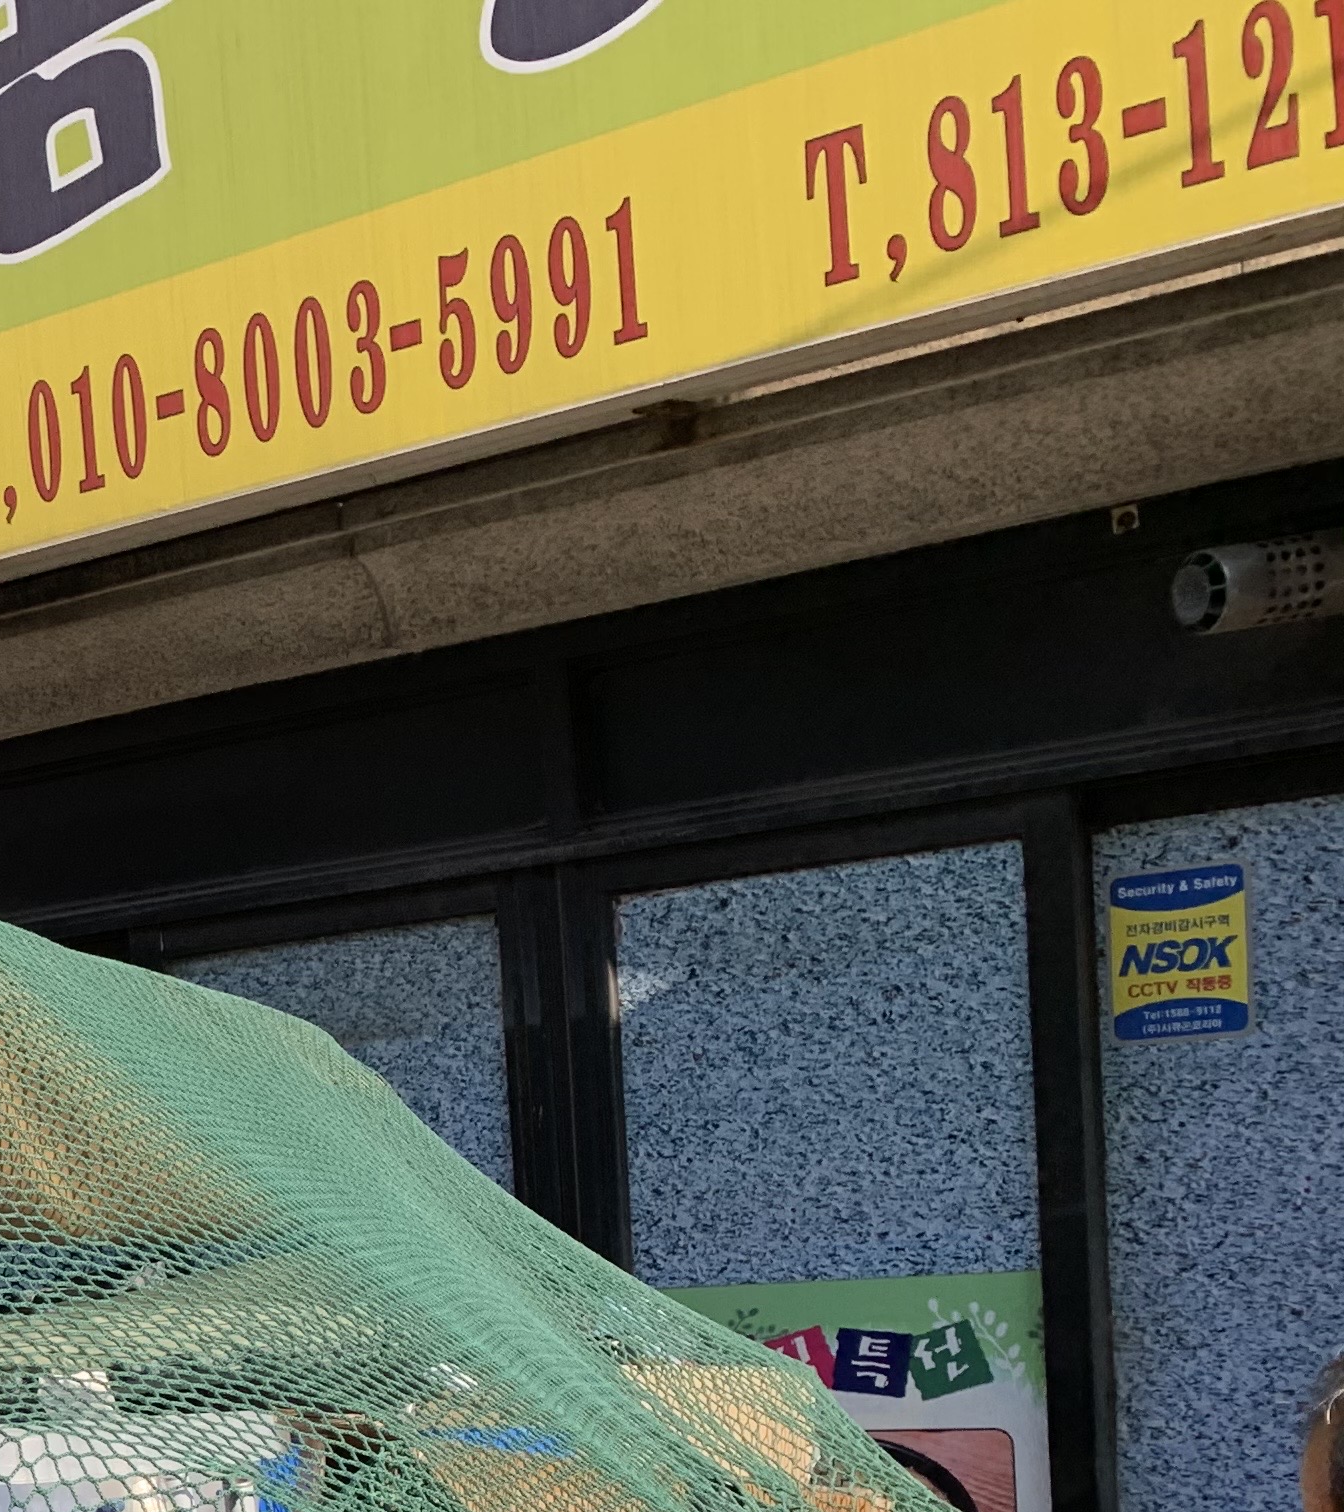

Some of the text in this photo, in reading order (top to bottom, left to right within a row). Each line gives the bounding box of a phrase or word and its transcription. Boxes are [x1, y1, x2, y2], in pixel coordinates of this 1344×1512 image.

[1117, 874, 1239, 899] Security & Safety
[1118, 934, 1238, 978] NSOK
[1127, 974, 1233, 998] CCTV 작동중
